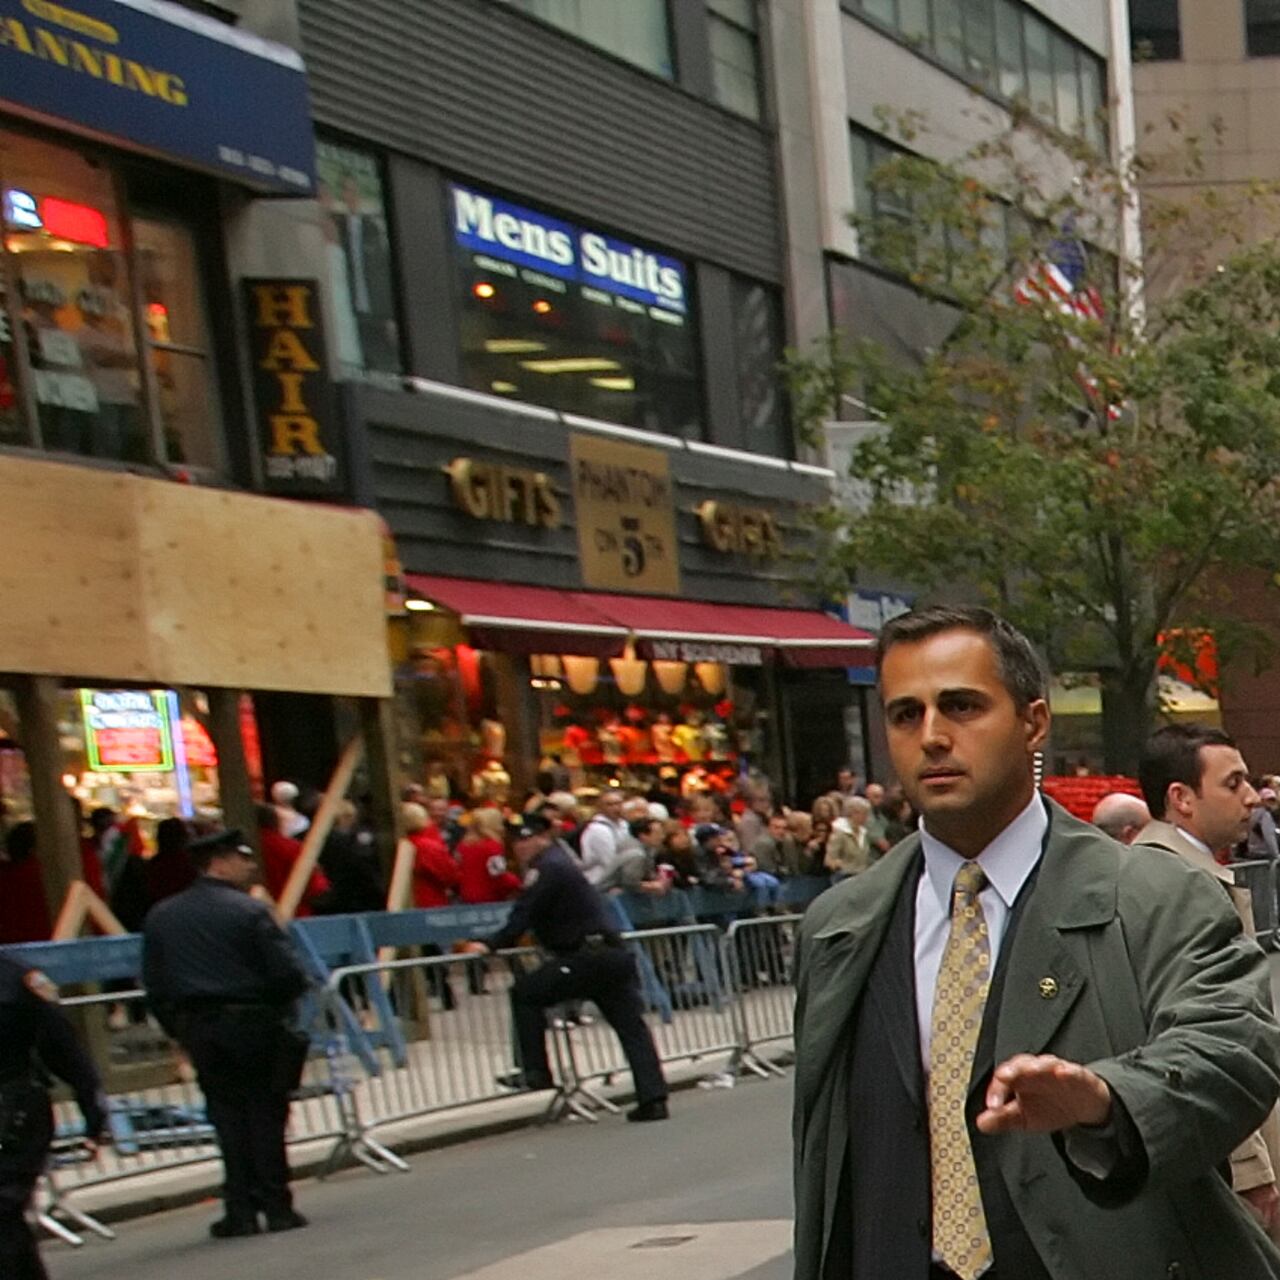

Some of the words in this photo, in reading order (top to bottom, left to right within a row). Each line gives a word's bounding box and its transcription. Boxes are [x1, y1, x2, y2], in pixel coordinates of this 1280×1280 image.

[453, 187, 575, 267] Mens
[580, 232, 685, 300] Suits
[254, 284, 320, 456] HAIR
[466, 464, 561, 529] GIFTS
